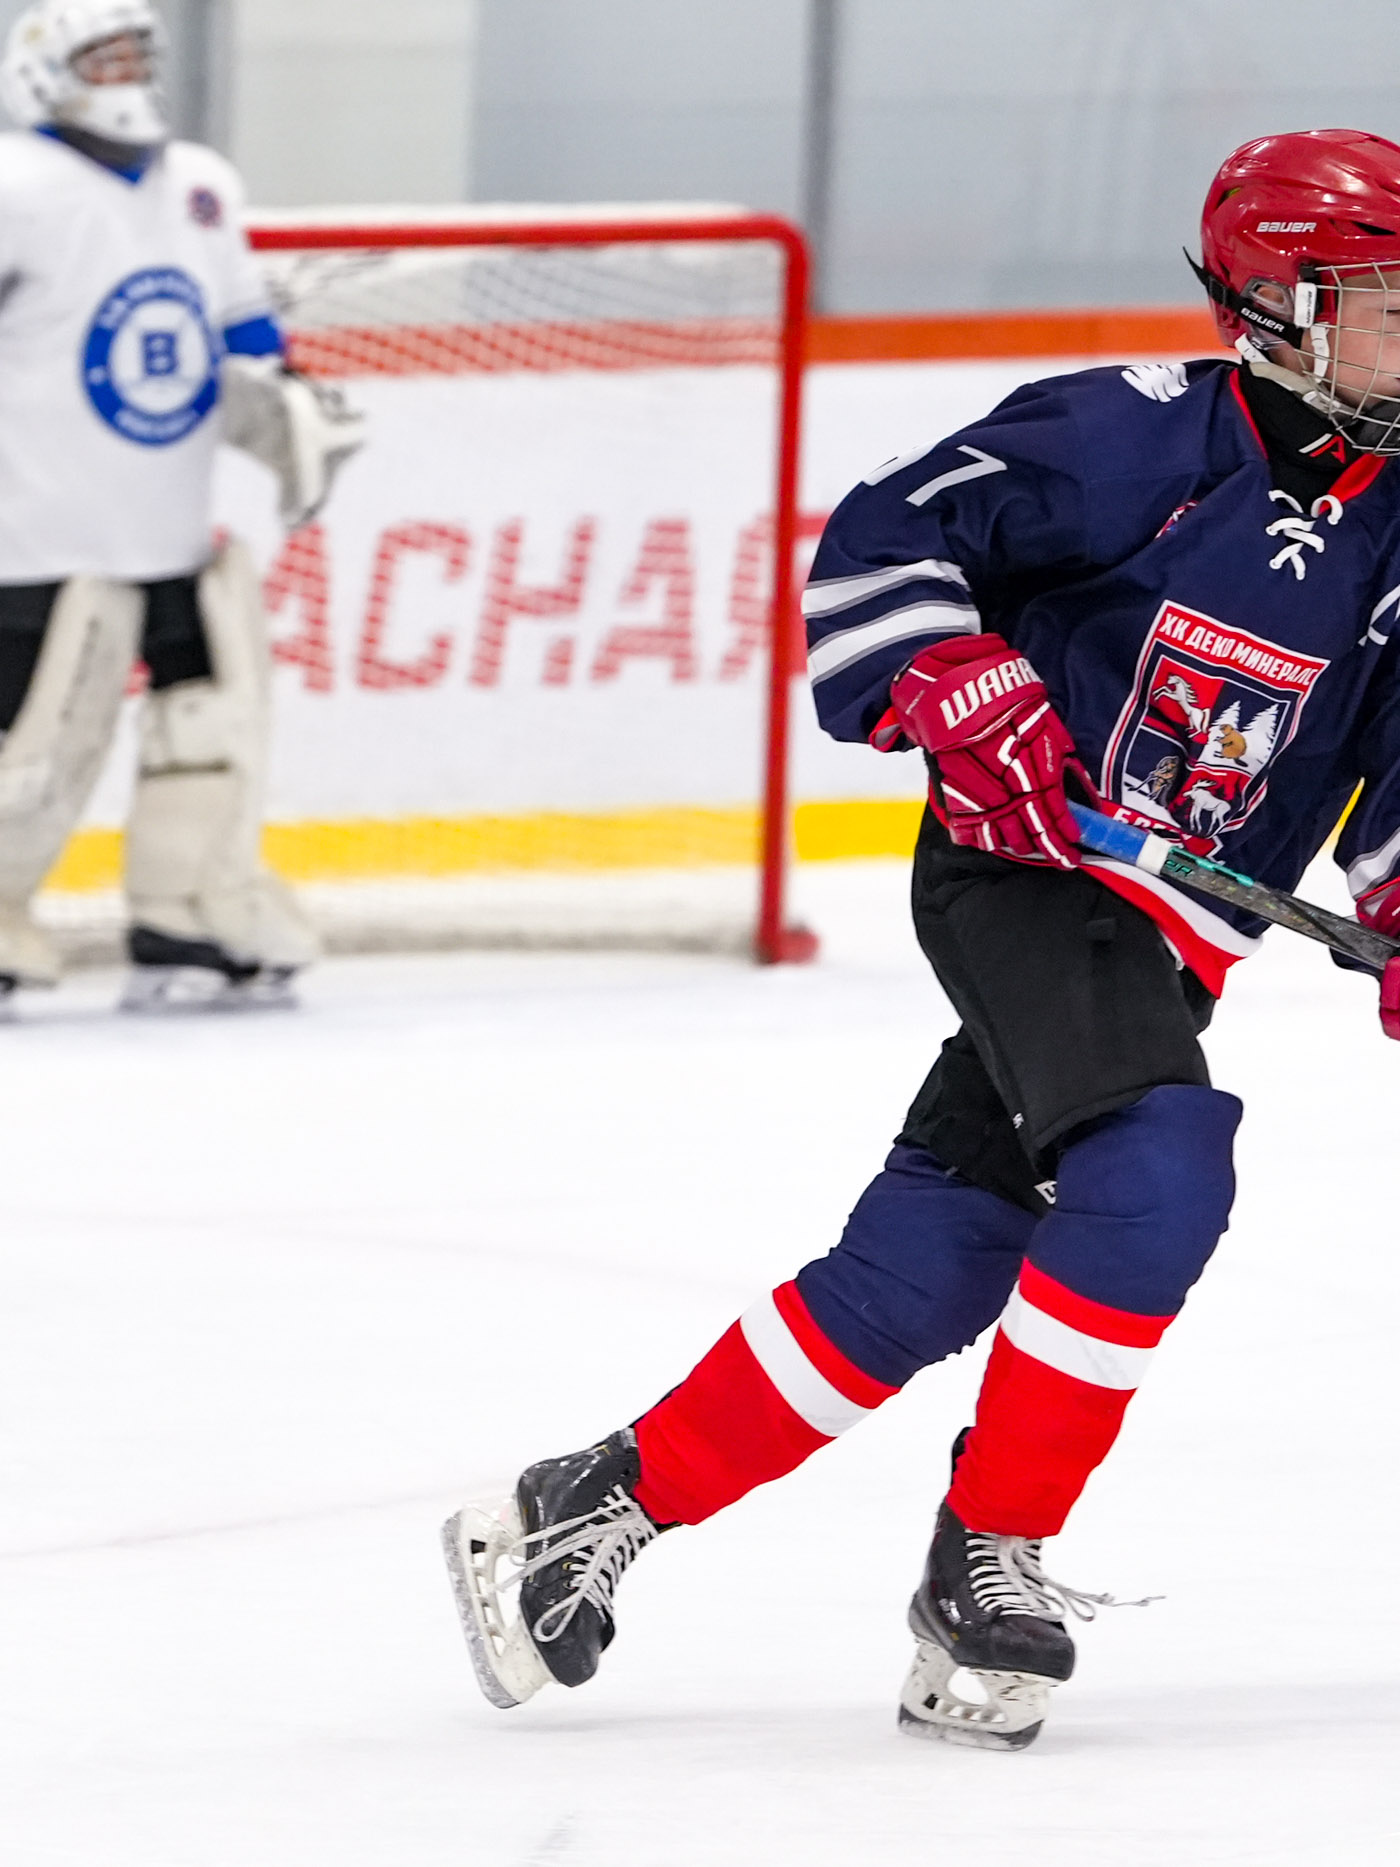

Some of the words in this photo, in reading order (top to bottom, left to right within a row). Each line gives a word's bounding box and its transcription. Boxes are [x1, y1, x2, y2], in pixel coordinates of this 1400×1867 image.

[1256, 221, 1317, 233] BAUER
[1240, 307, 1285, 332] BAUER
[1158, 612, 1191, 641] ХК
[1185, 625, 1233, 658] ДЕКО
[1230, 641, 1319, 686] МИНЕРАЛС
